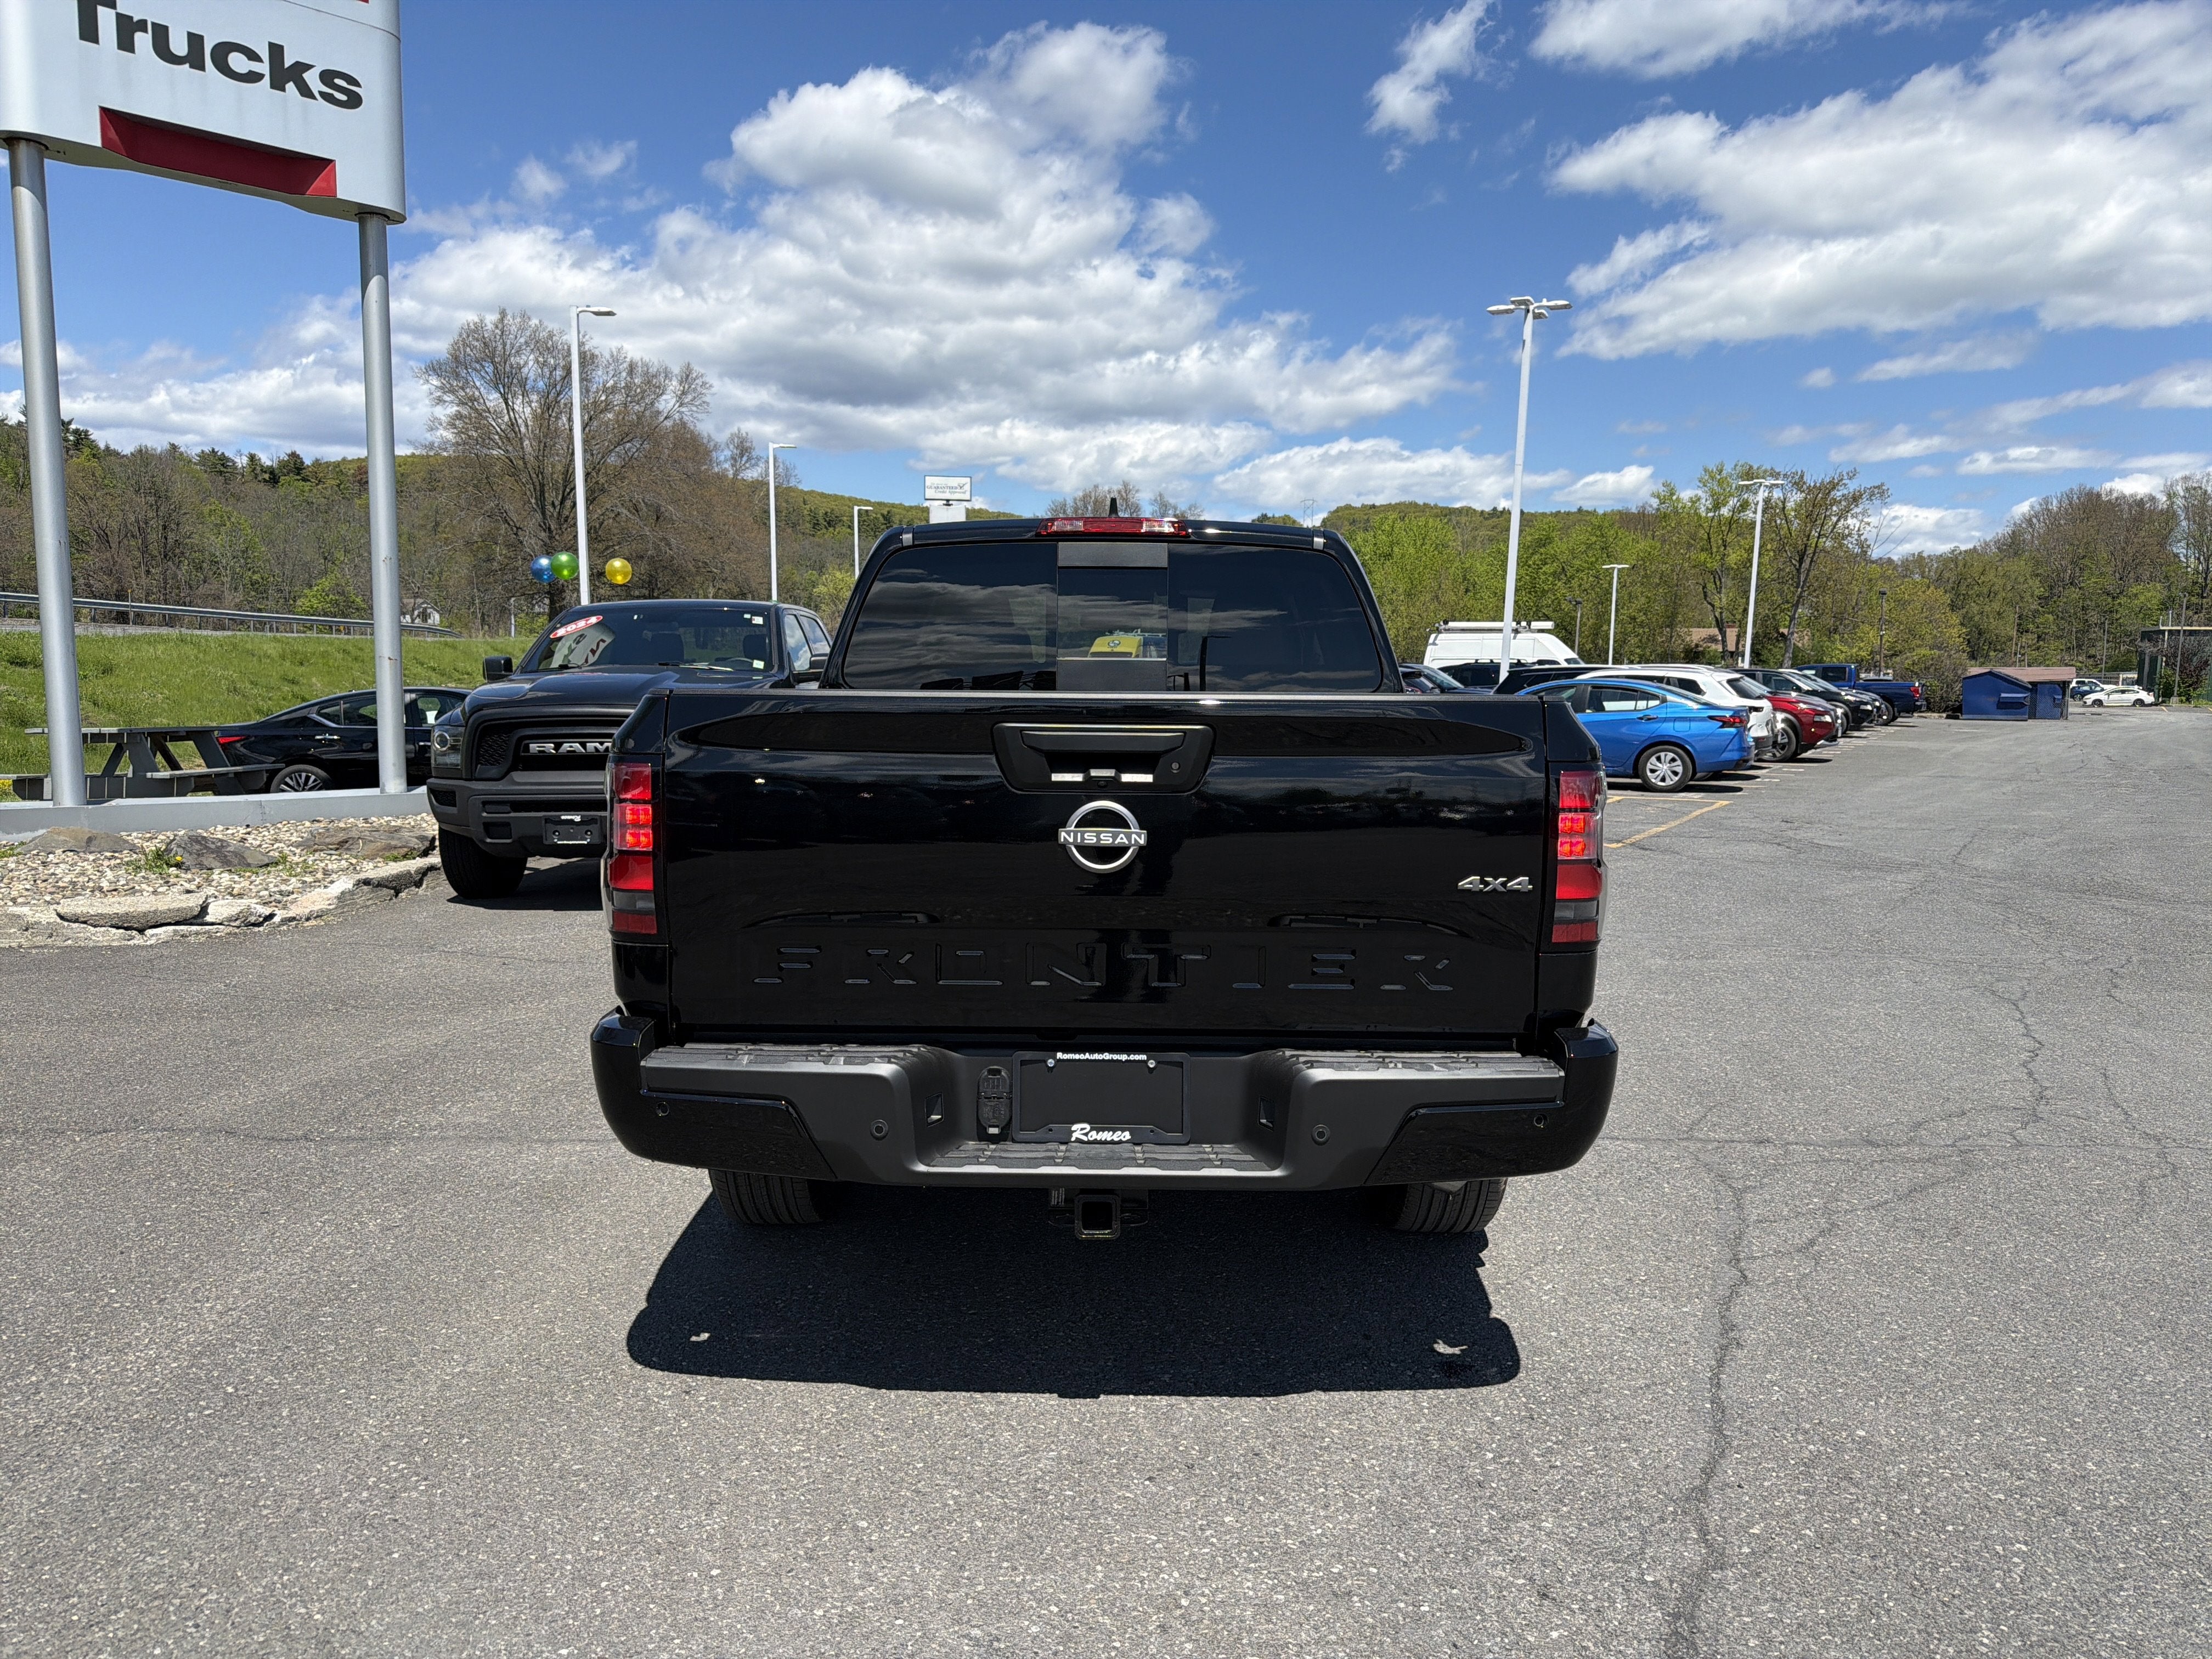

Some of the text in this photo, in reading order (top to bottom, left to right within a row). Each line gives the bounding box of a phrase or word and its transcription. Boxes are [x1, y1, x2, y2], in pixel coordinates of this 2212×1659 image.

[77, 0, 363, 110] Trucks
[556, 617, 597, 636] 2024
[529, 743, 613, 753] RAM
[1060, 832, 1144, 844] NISSAN
[753, 941, 1454, 991] FRONTIER
[1057, 1052, 1147, 1061] RomeoAutoGroup.com
[1071, 1124, 1131, 1141] Romeo
